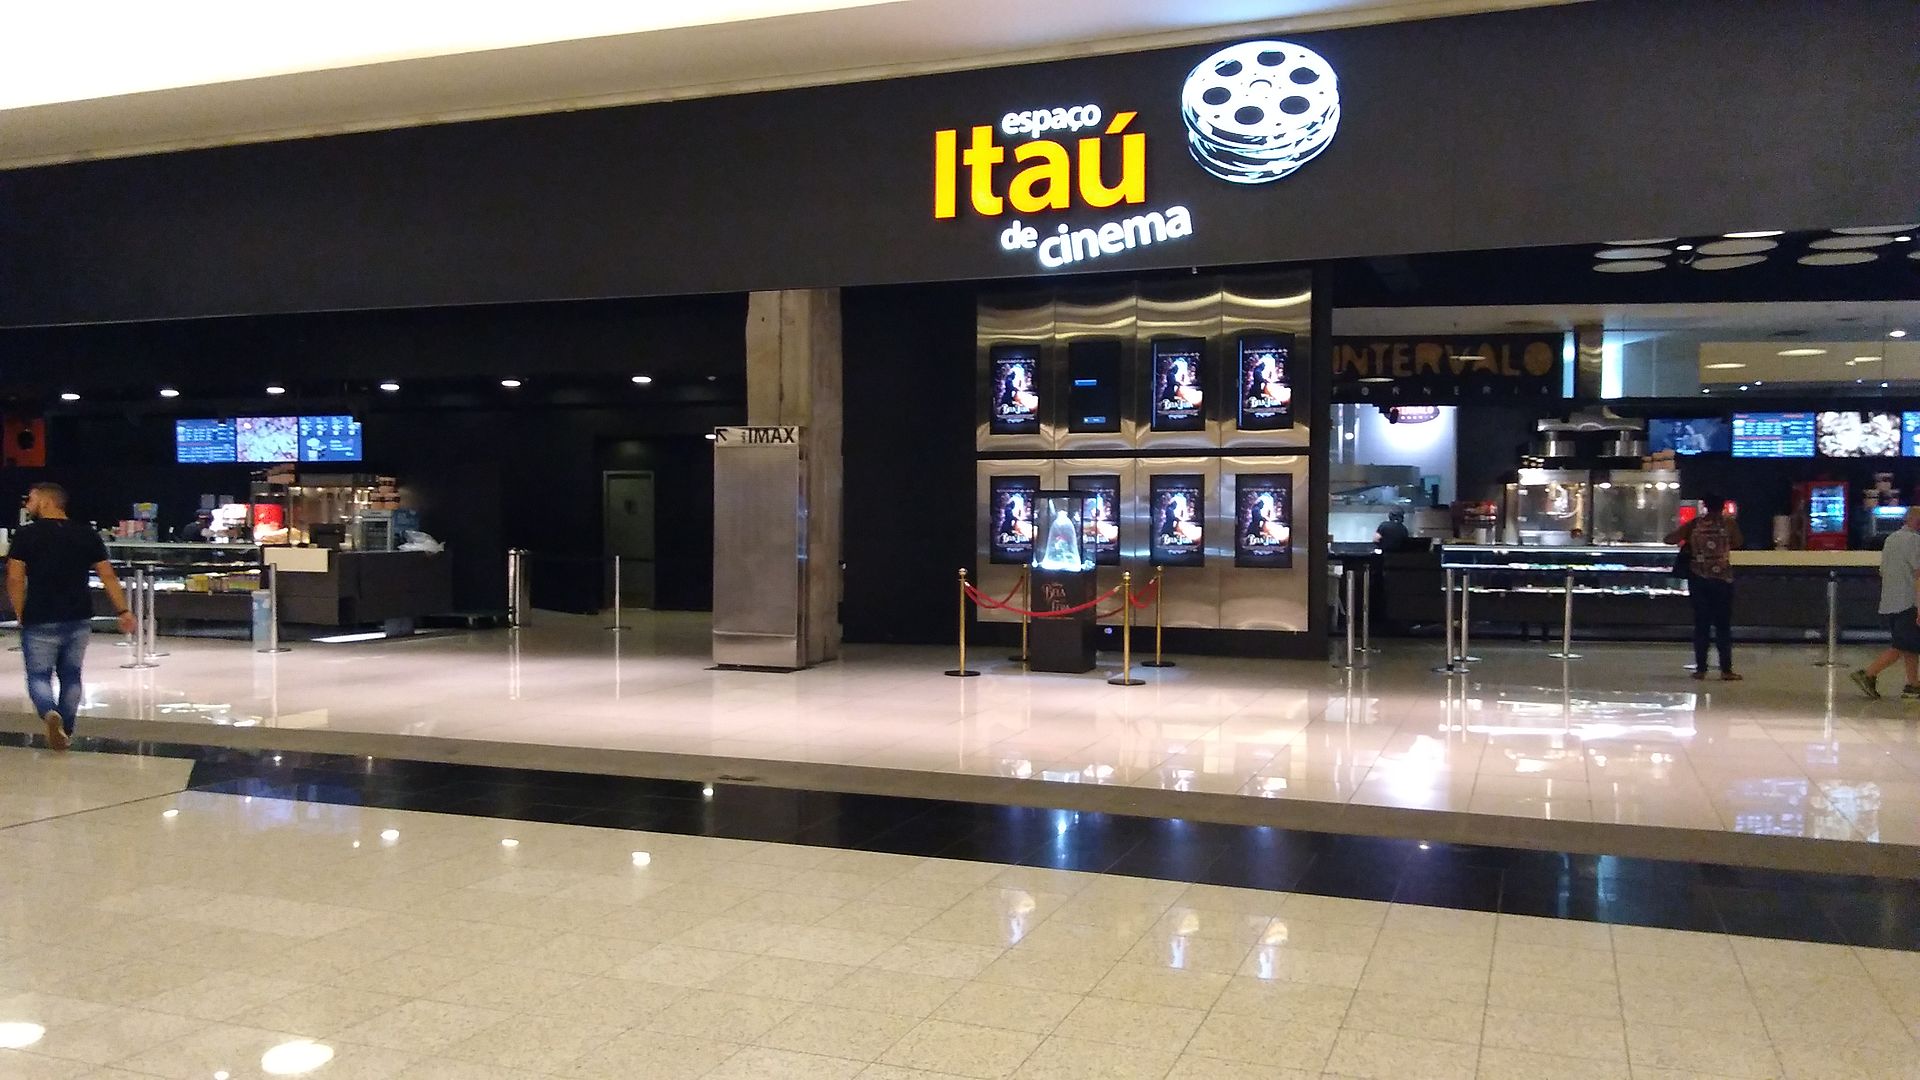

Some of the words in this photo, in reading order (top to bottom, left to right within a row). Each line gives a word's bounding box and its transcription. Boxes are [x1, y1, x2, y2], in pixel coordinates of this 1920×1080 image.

[1002, 103, 1102, 138] espaço
[934, 111, 1147, 220] Itaú
[1000, 220, 1039, 250] de
[1037, 205, 1193, 268] cinema
[1331, 341, 1553, 377] INTERVALO
[748, 426, 795, 444] IMAX
